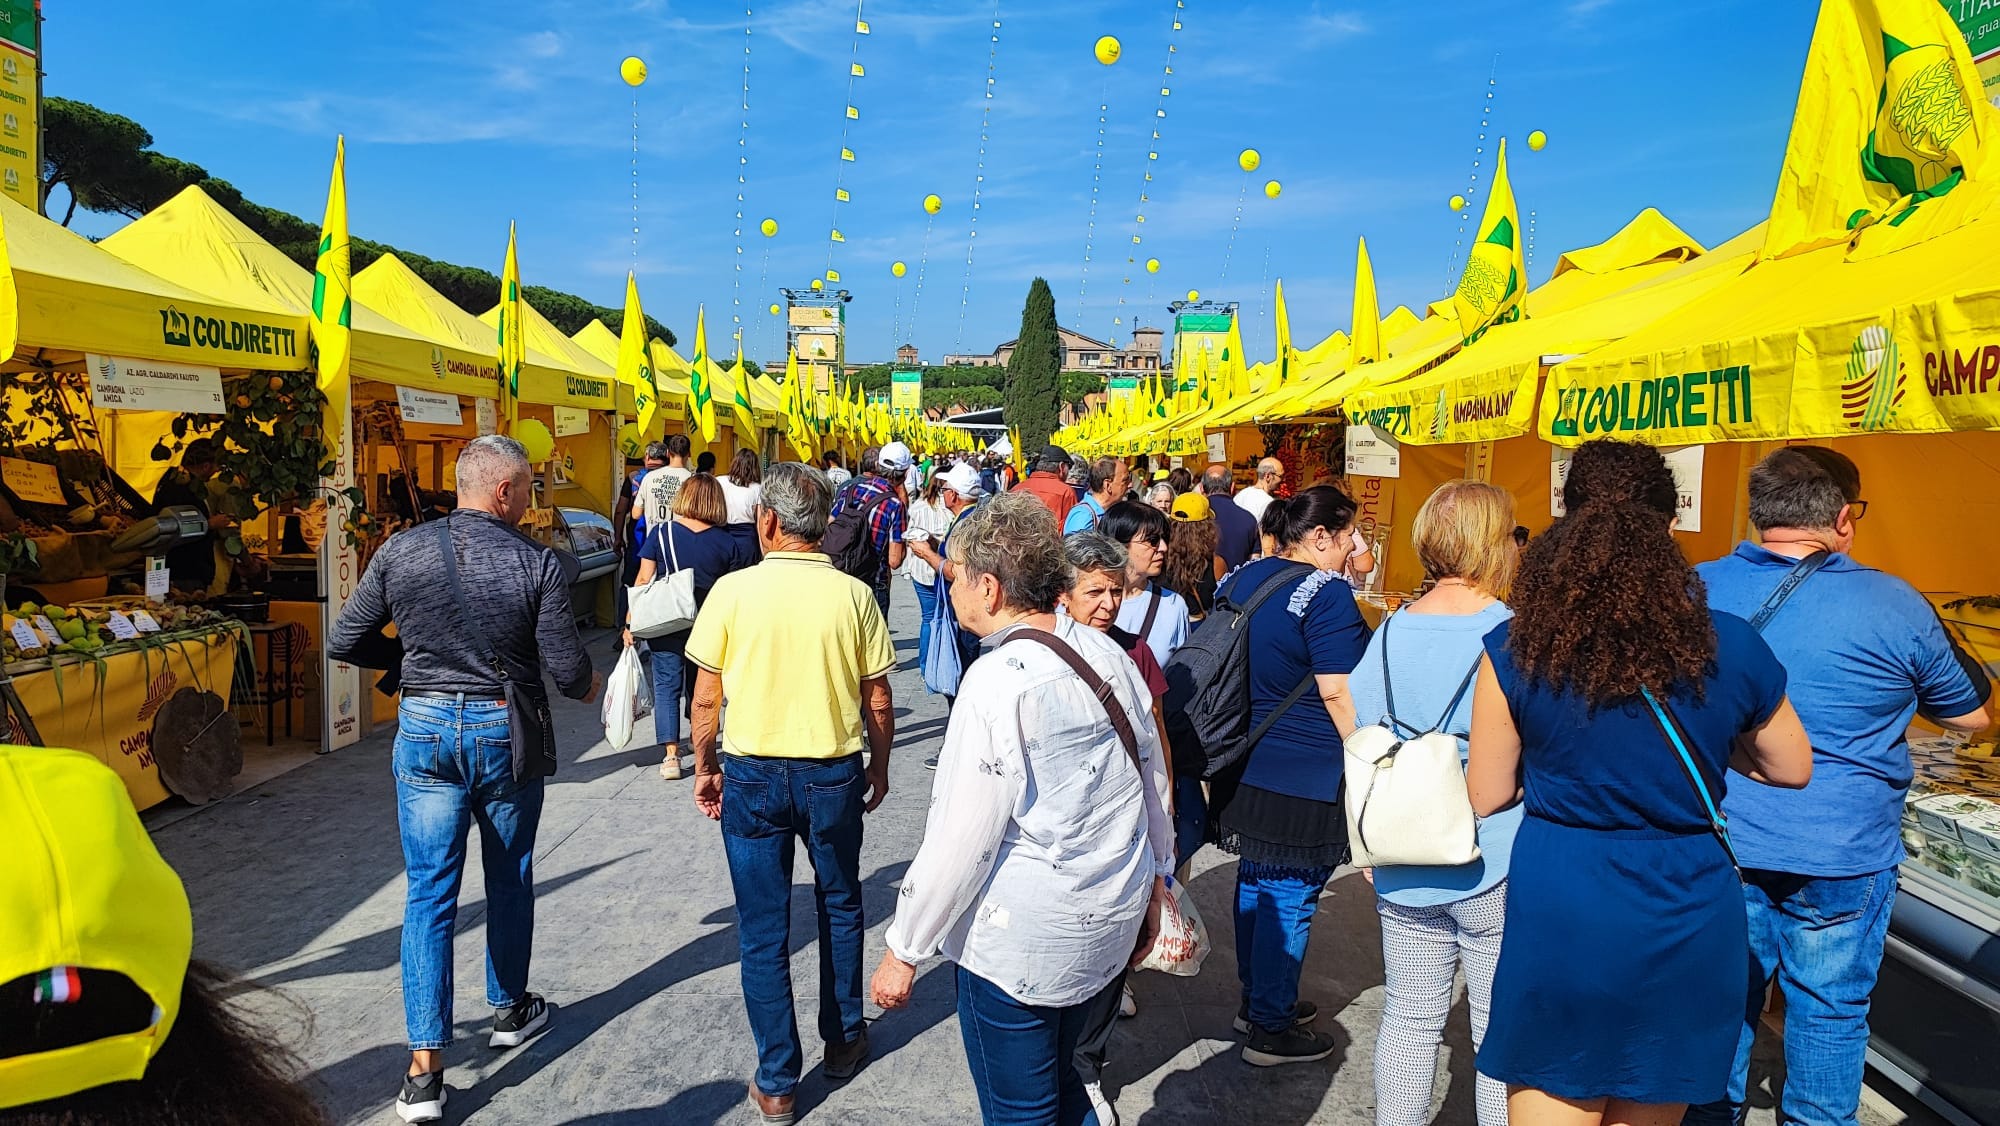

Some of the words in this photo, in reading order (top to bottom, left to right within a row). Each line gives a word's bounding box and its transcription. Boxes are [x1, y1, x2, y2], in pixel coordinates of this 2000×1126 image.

[0, 89, 27, 105] OLDIRETTI
[0, 144, 27, 159] OLDIRETTI
[193, 316, 296, 357] COLDIRETTI
[447, 360, 478, 378] CAMPAGNA
[1924, 345, 2000, 397] CAMP
[96, 384, 125, 394] CAMPAGNA
[575, 378, 609, 398] COLDIRETTI
[103, 394, 123, 404] AMICA
[1583, 365, 1753, 434] COLDIRETTI
[334, 717, 355, 728] CAMPAGNA
[337, 725, 352, 735] AMICA
